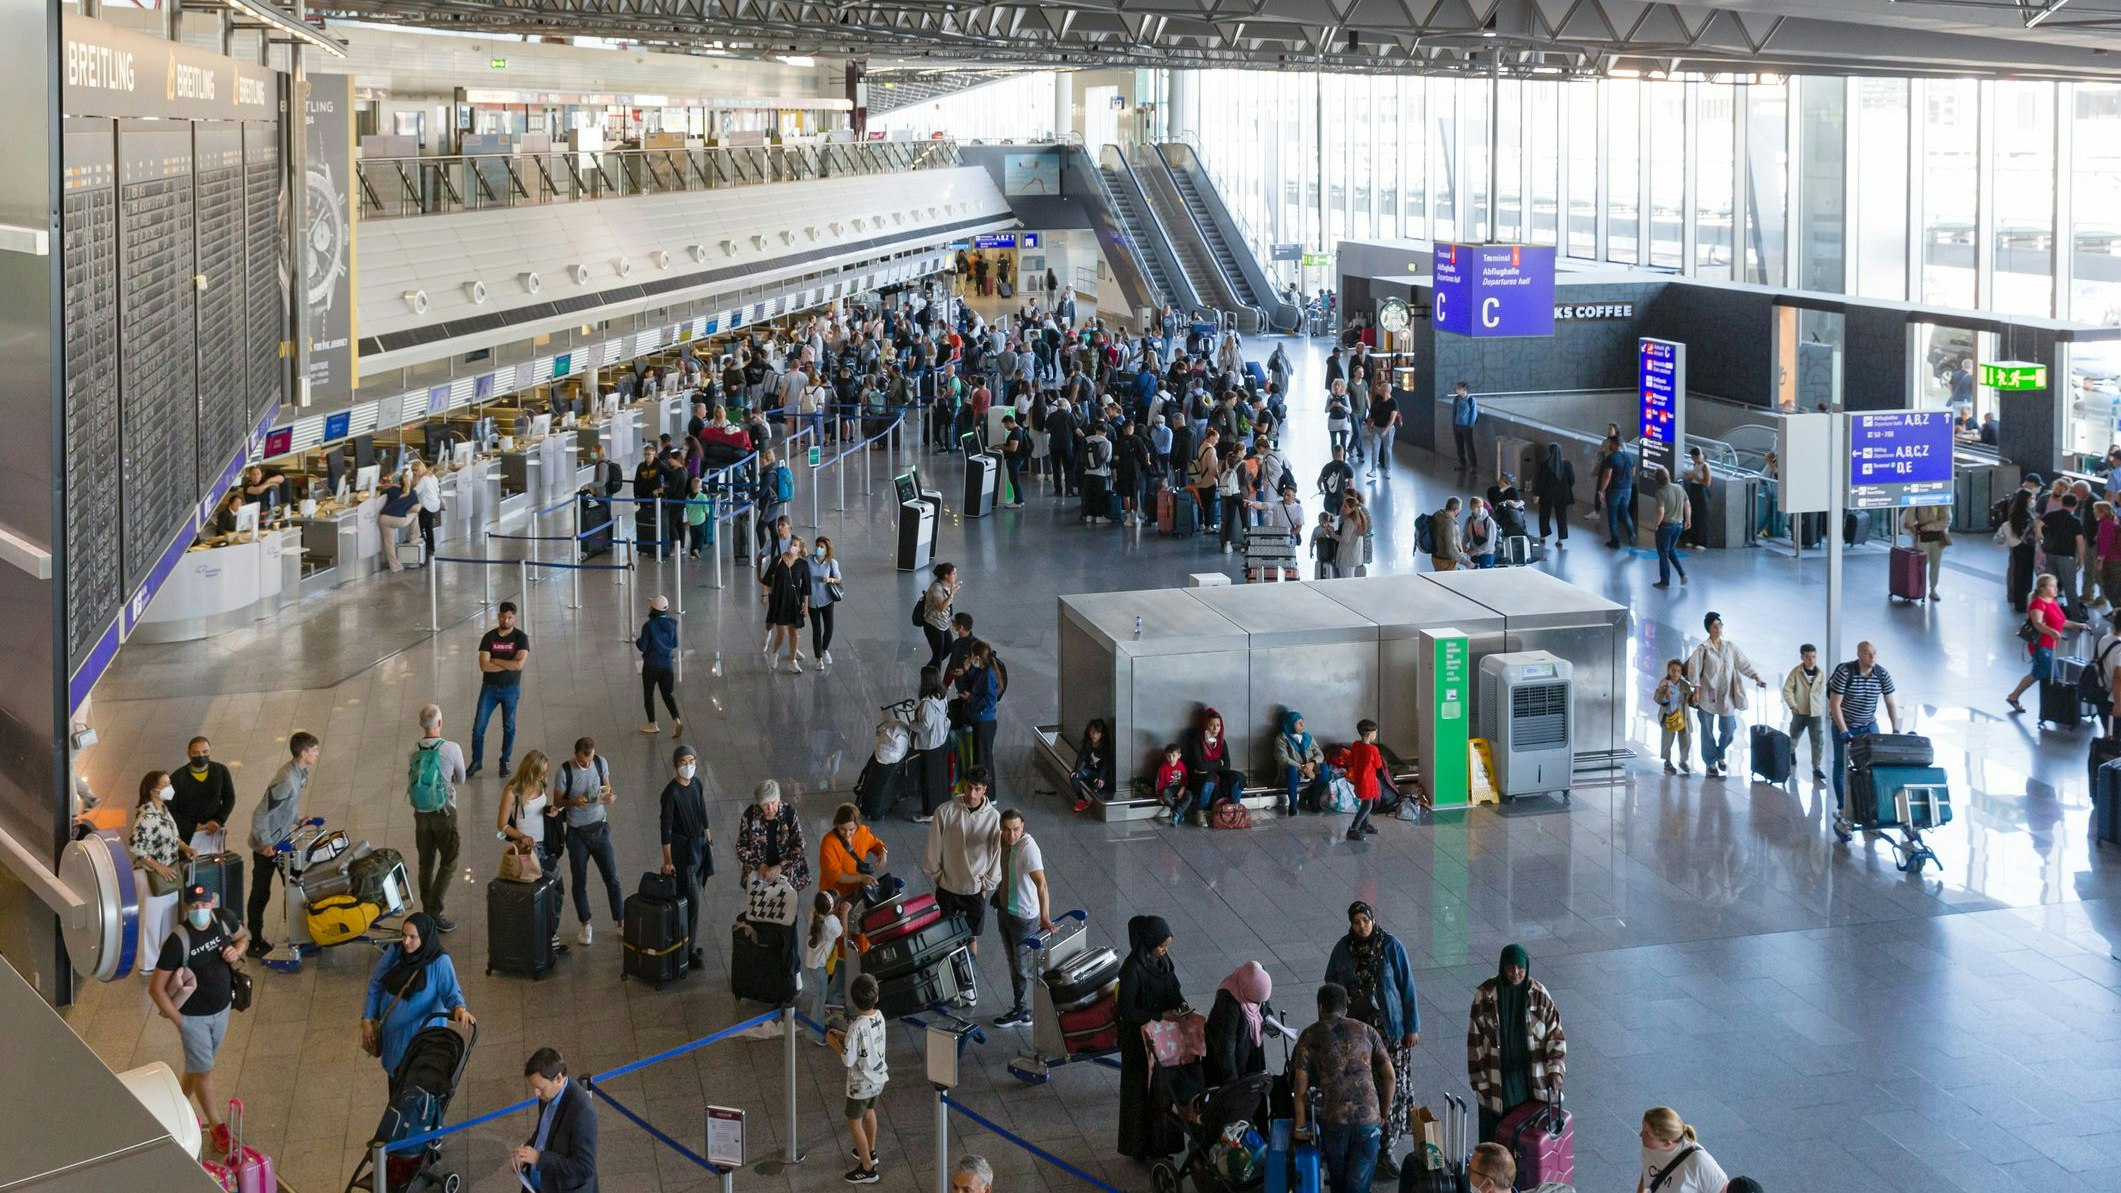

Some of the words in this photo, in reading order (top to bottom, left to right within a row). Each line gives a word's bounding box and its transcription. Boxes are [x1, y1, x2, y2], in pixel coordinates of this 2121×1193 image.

[68, 41, 135, 92] BREITLING
[177, 63, 215, 100] BREITLING
[239, 76, 265, 106] BREITLING
[280, 100, 334, 113] BTLING
[1483, 253, 1511, 263] Terminal
[1482, 267, 1520, 277] Abflughalle
[1482, 277, 1517, 287] Departures
[1518, 277, 1532, 285] hall
[1436, 292, 1446, 322] C
[1482, 297, 1500, 328] C
[1553, 306, 1573, 319] KS
[1575, 305, 1633, 318] COFFEE
[1664, 346, 1671, 358] C
[1904, 413, 1929, 426] A,B,Z
[1895, 445, 1929, 458] A,B,C,Z
[1897, 461, 1912, 474] D,E
[191, 936, 221, 956] GIVENC
